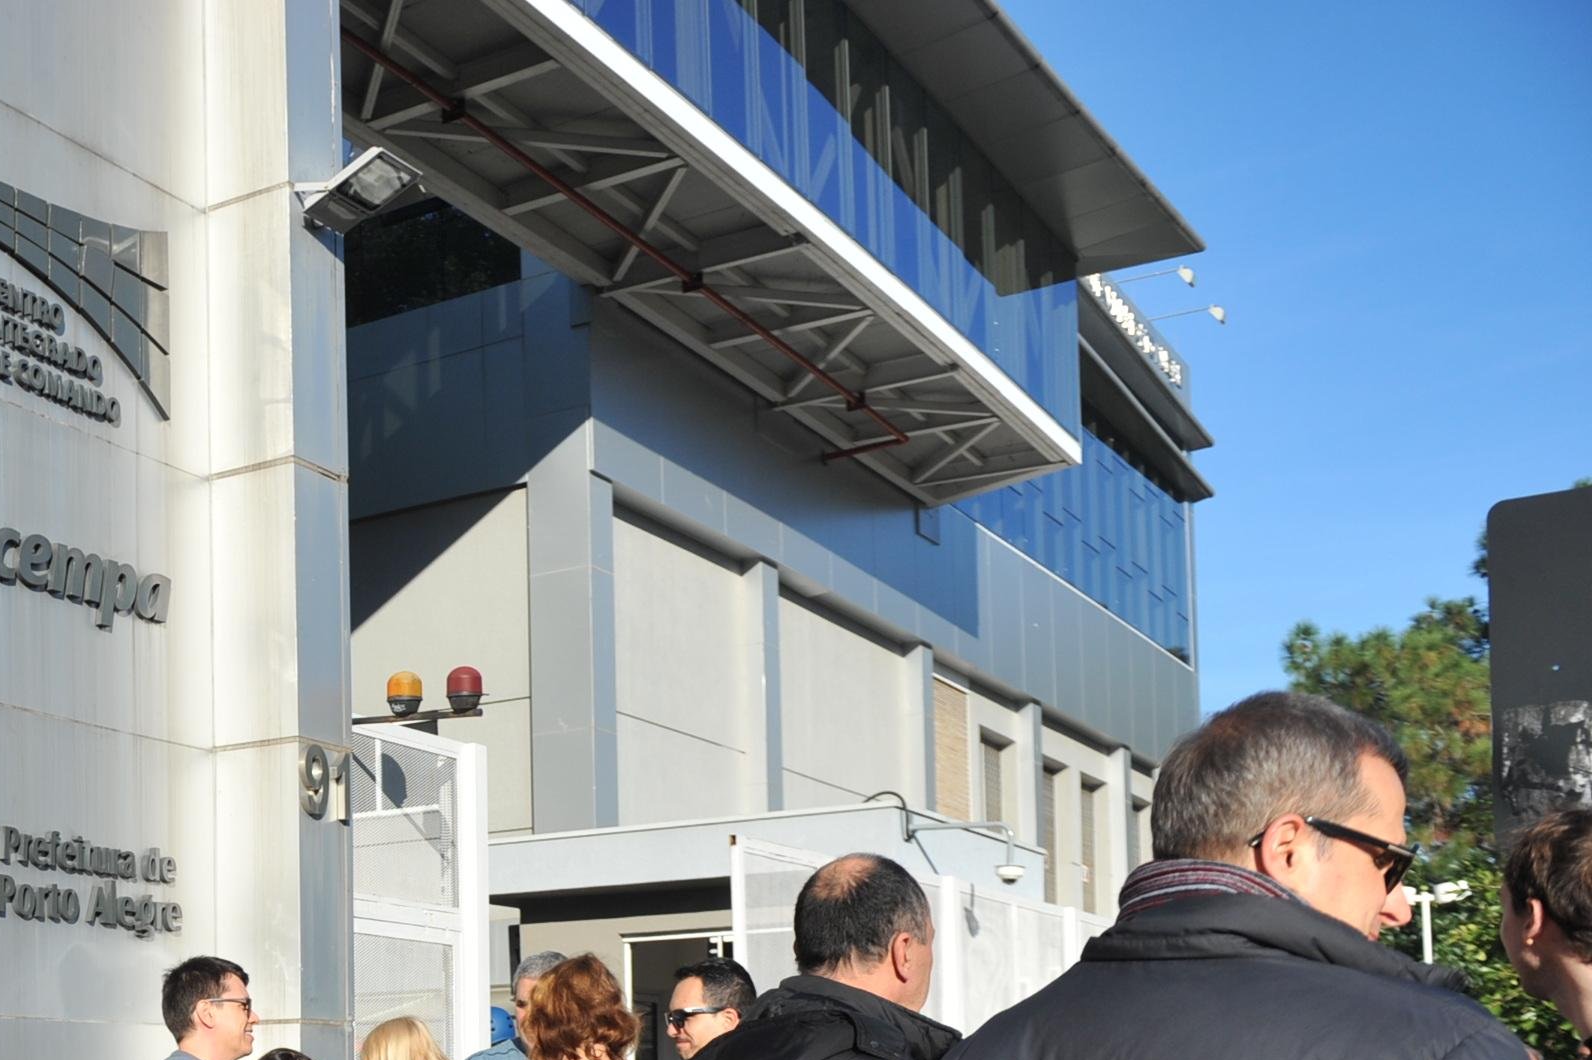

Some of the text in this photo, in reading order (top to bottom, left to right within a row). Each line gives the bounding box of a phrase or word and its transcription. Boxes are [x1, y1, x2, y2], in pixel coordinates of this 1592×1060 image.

[13, 358, 121, 428] COMANDO
[298, 744, 350, 826] 91
[141, 848, 177, 884] de
[85, 880, 184, 938] Alegre
